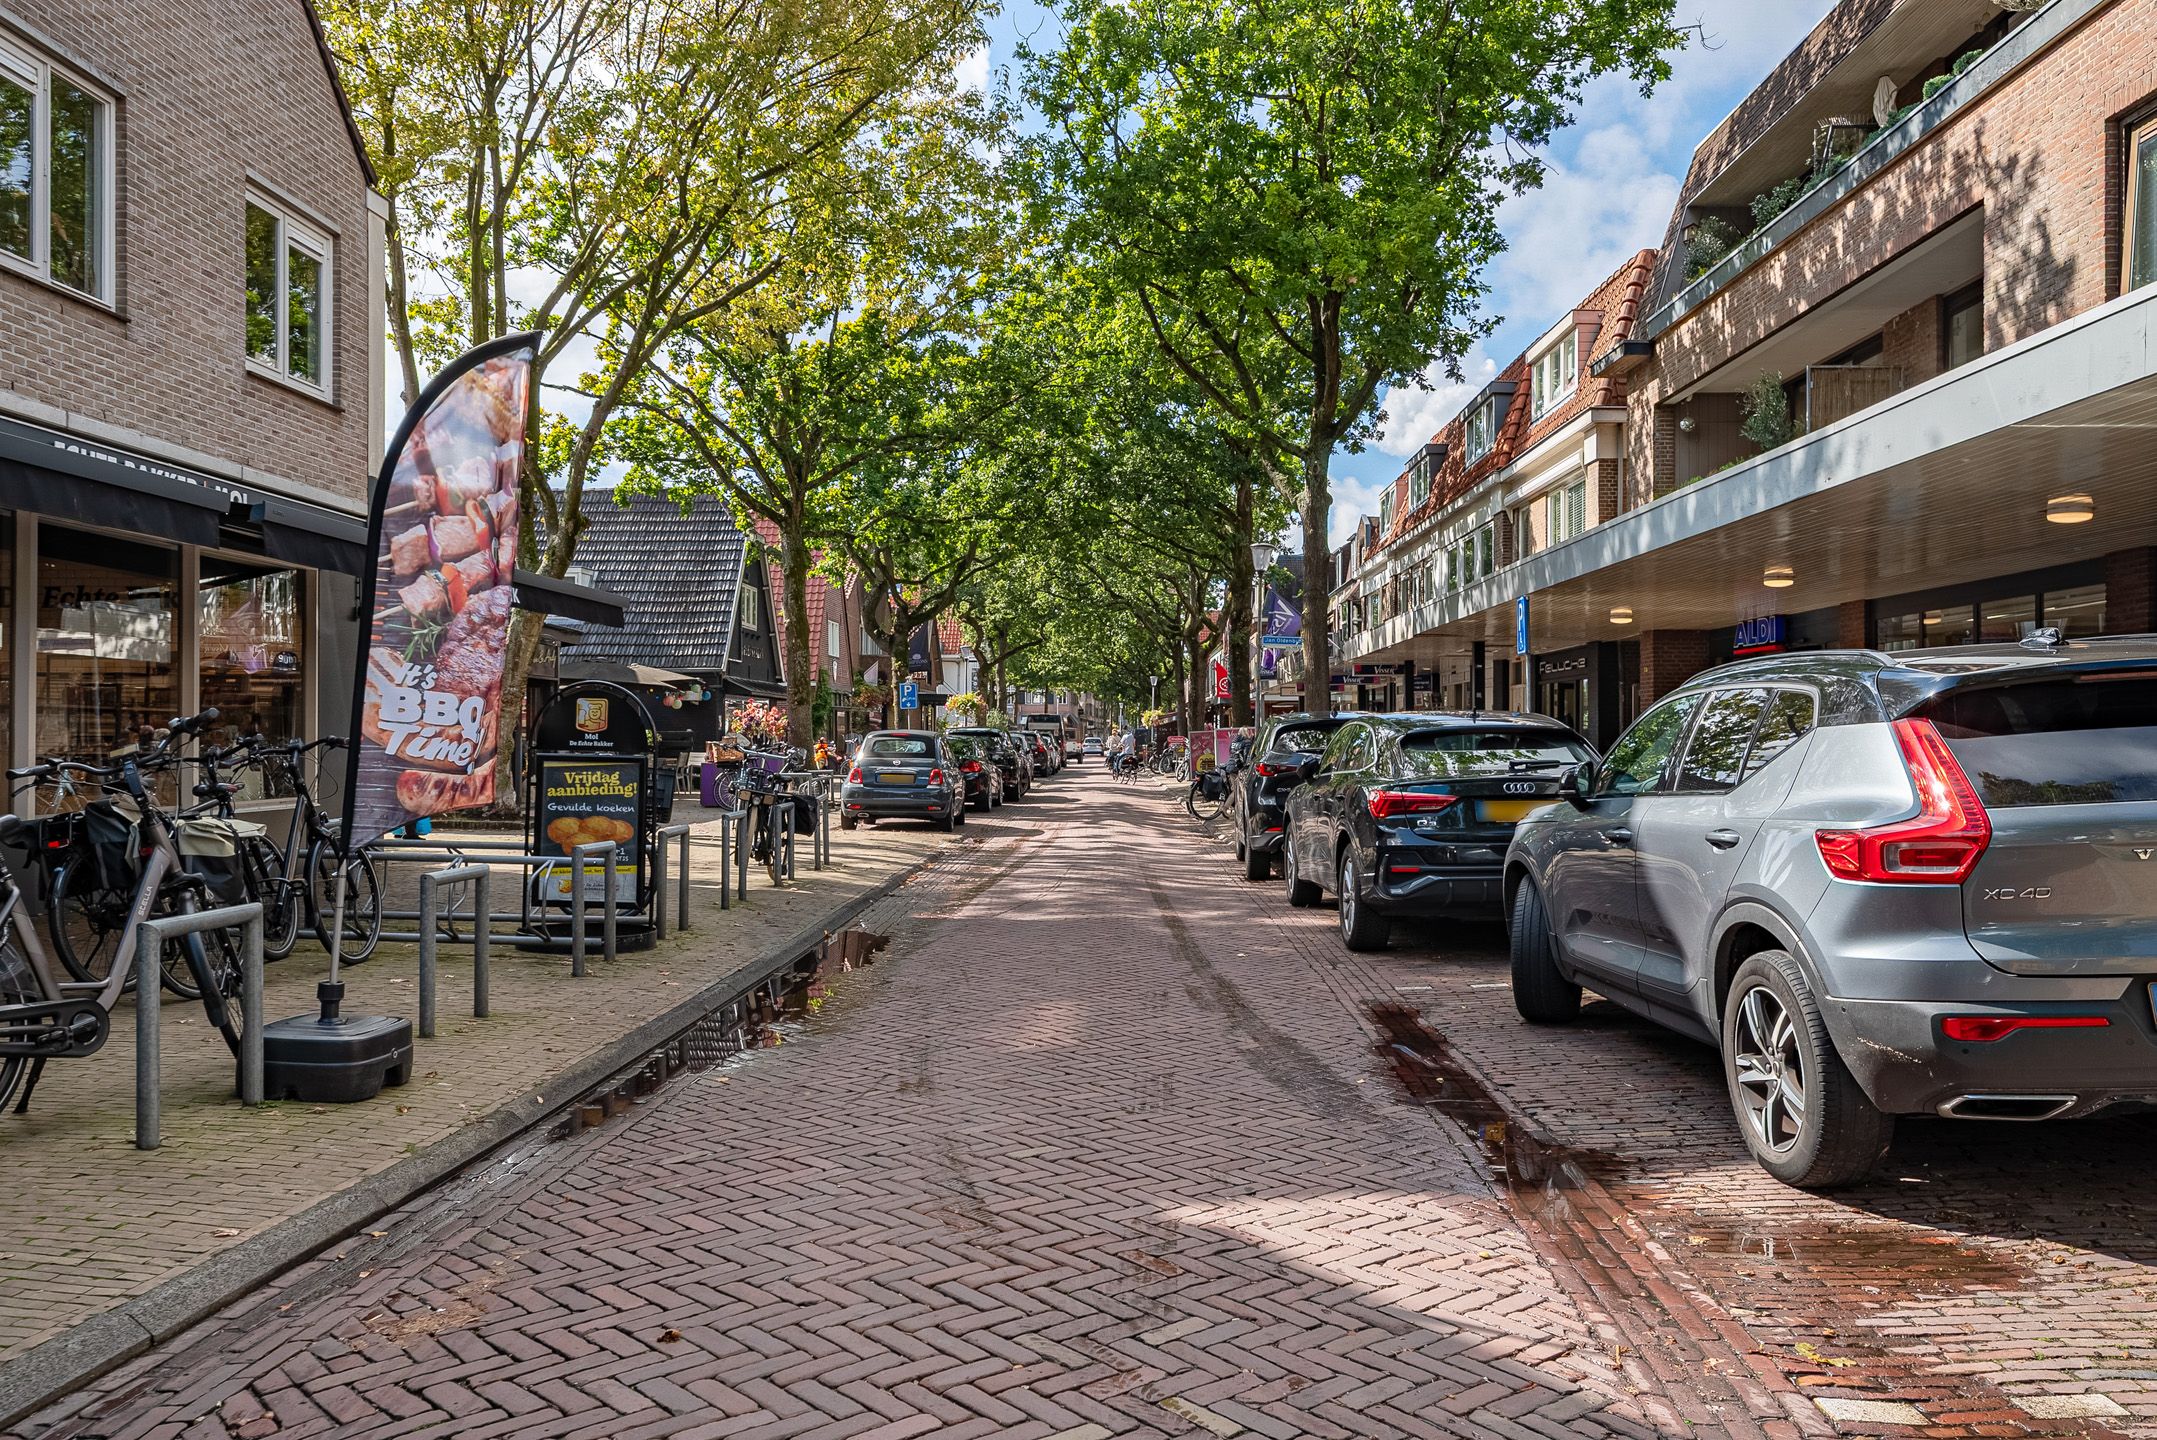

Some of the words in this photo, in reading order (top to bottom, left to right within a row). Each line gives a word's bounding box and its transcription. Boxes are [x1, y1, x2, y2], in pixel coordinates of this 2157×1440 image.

[1733, 615, 1776, 648] ALDI
[395, 662, 438, 690] It's
[904, 685, 912, 696] P
[378, 686, 486, 743] BBQ
[377, 721, 487, 776] Time!
[547, 782, 638, 798] aanbieding!
[564, 771, 620, 787] Vrijdag
[547, 802, 593, 812] Gevulde
[596, 803, 635, 813] koeken
[137, 886, 153, 917] STELLA
